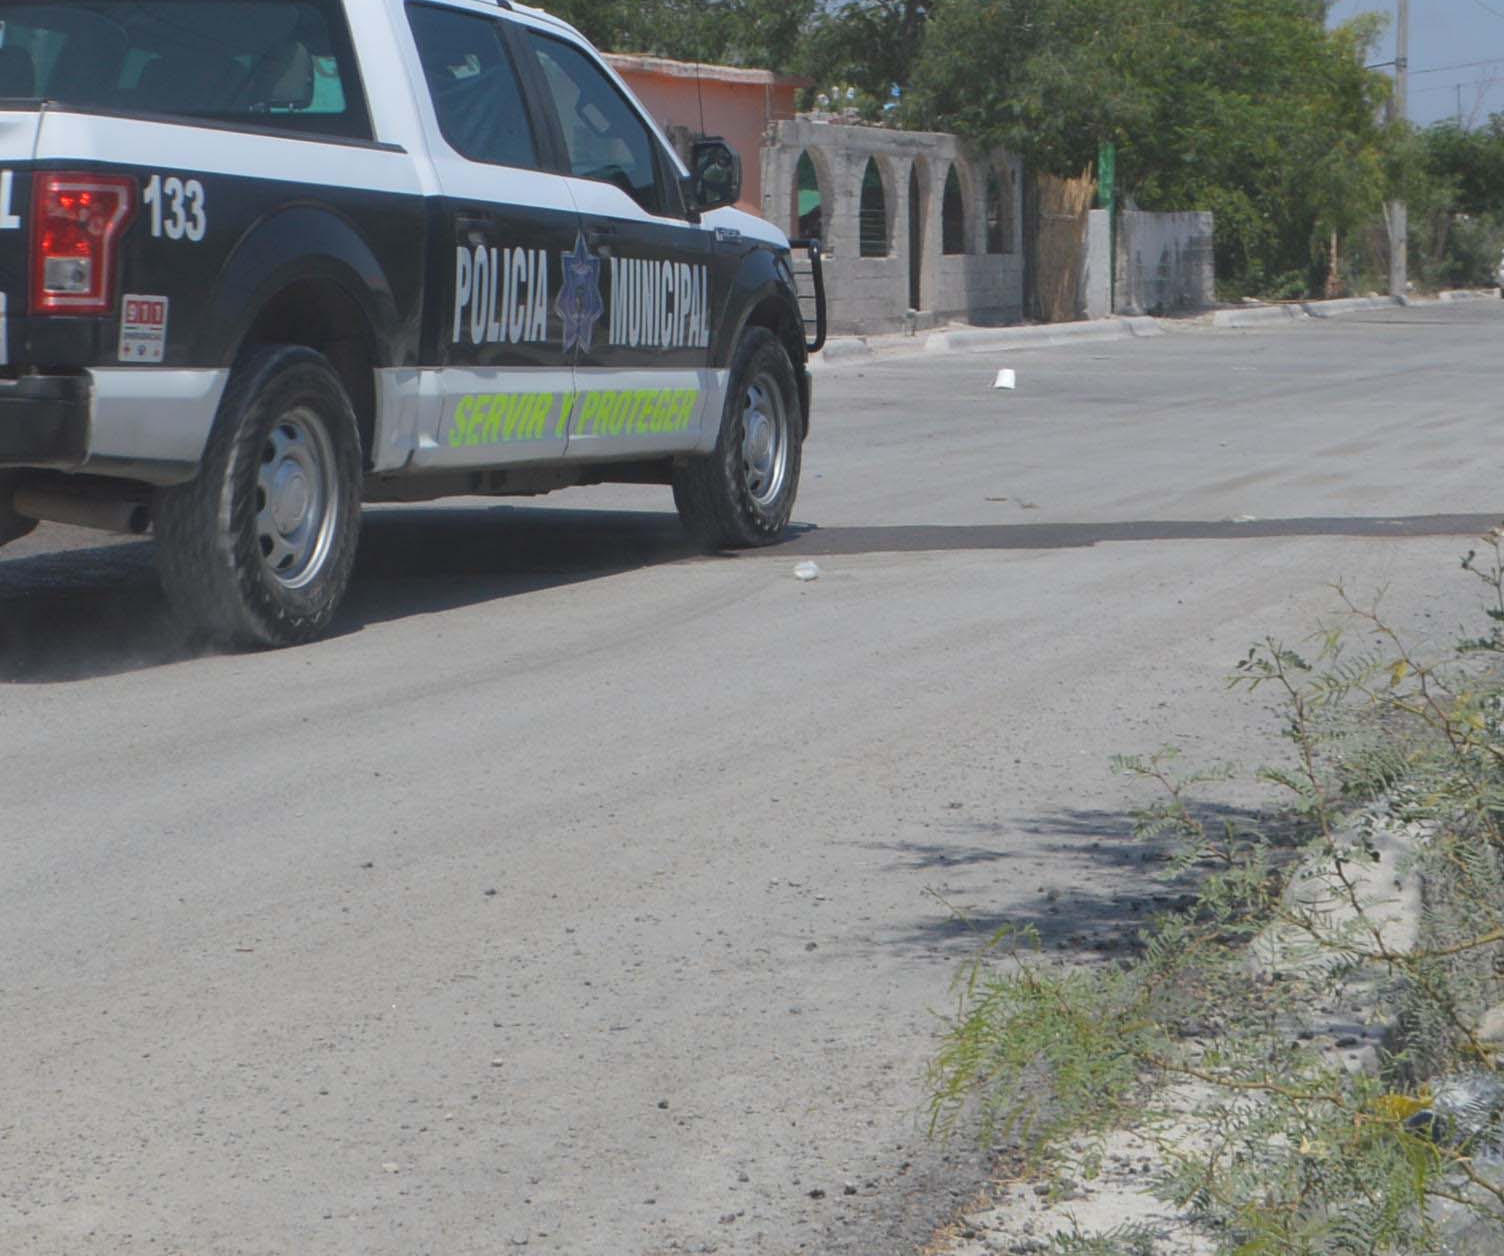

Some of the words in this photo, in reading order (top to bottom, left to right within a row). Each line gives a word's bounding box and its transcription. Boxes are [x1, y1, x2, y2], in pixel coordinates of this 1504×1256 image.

[144, 174, 206, 241] 133
[453, 244, 547, 344] POLICIA
[609, 256, 709, 348] MUNICIPAL
[451, 393, 552, 446] SERVIR
[556, 391, 577, 437] Y
[577, 388, 698, 436] PROTEGER
